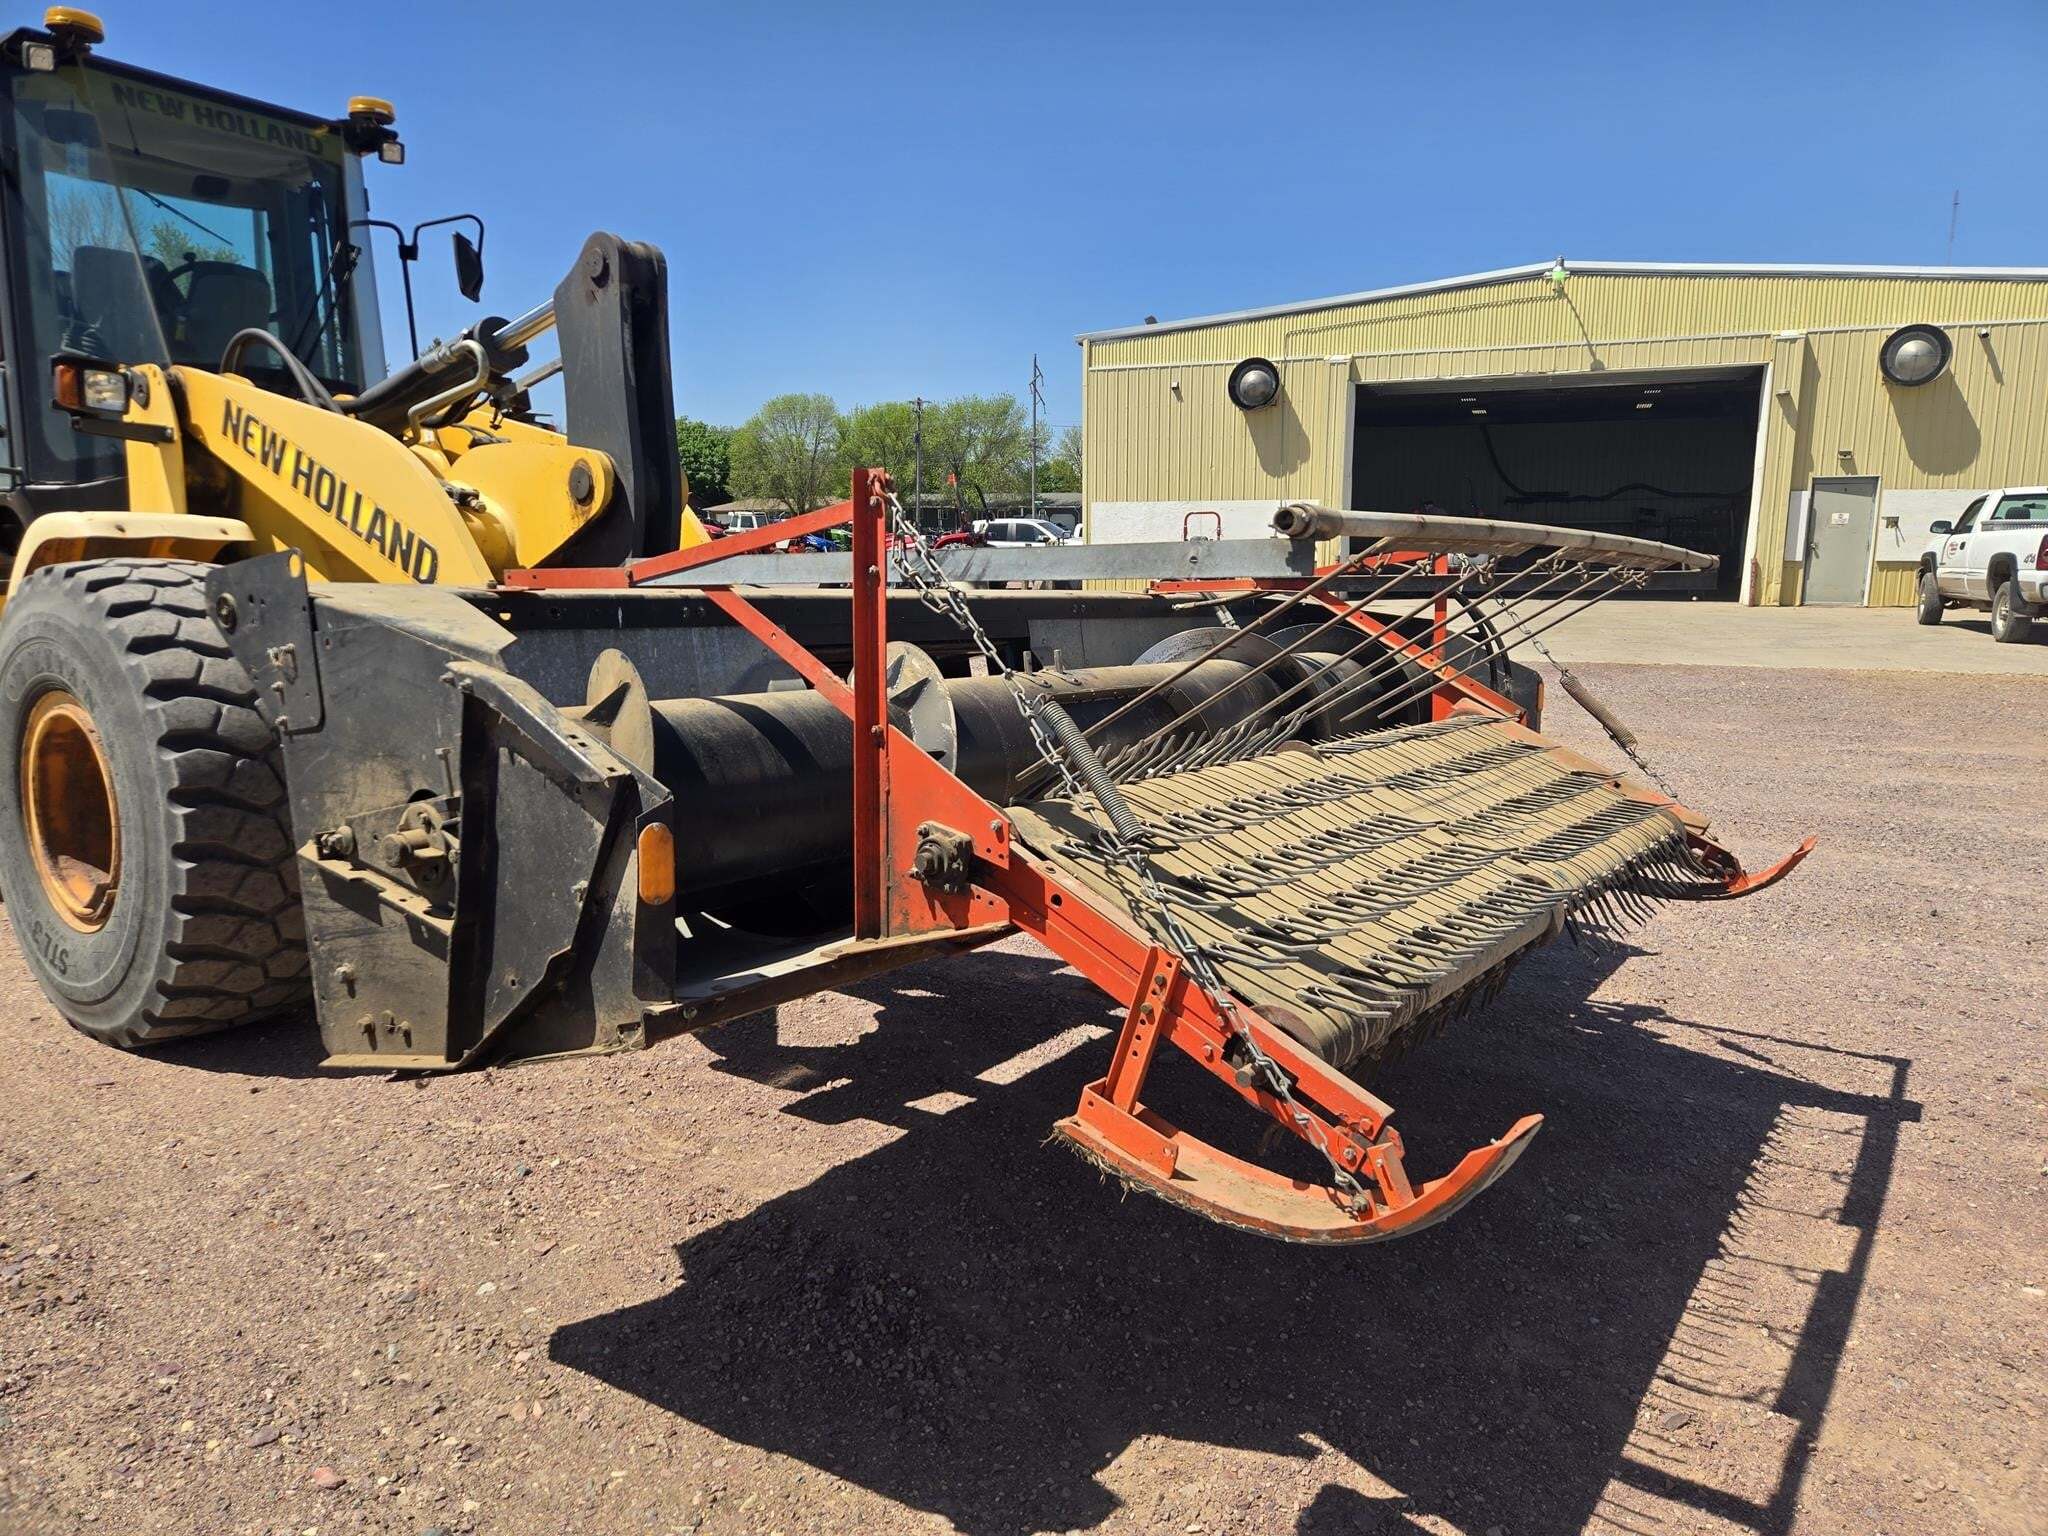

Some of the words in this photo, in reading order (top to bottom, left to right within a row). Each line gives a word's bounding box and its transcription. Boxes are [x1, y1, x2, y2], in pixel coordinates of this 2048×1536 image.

[111, 82, 186, 120] NEW
[193, 104, 324, 155] HOLLAND
[222, 397, 288, 476] NEW
[291, 447, 439, 584] HOLLAND
